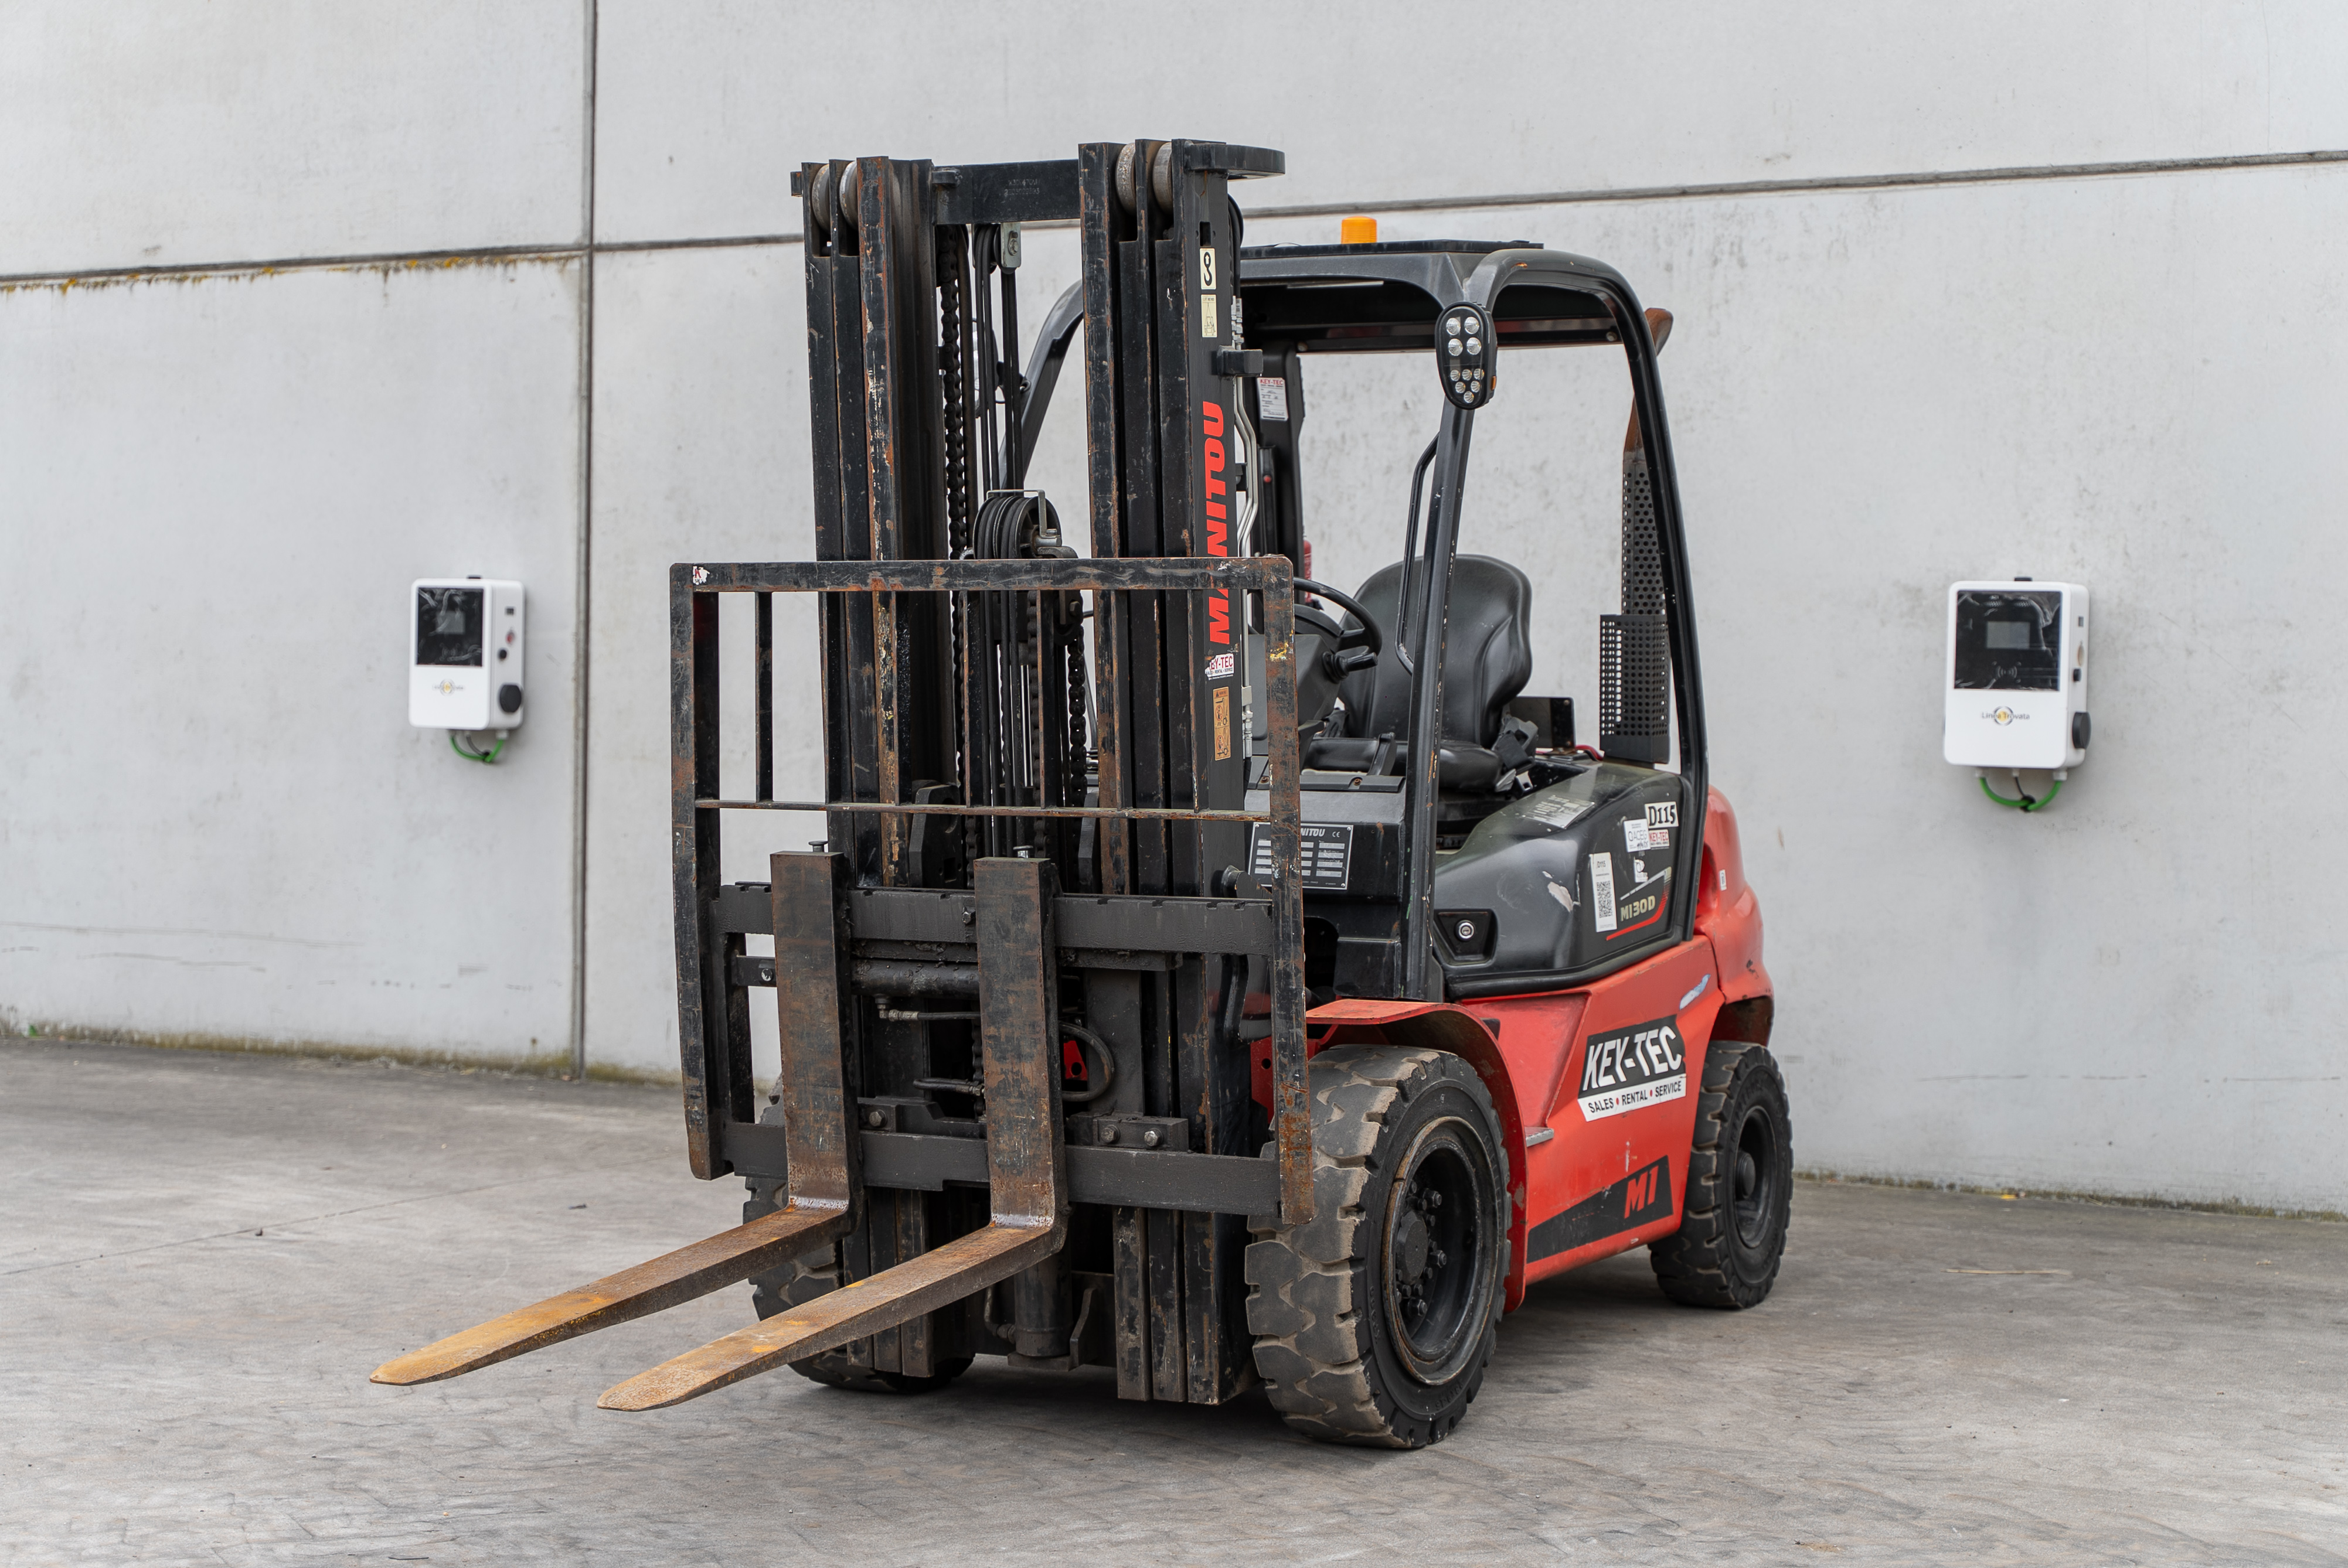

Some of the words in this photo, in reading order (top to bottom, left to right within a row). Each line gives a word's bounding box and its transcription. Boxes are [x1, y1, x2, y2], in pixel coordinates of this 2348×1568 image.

[1203, 401, 1230, 645] MNITOU
[1210, 656, 1233, 669] EY-TEC
[2003, 711, 2030, 720] Trovata
[1648, 805, 1676, 826] D115
[1301, 827, 1326, 837] NITOU
[1583, 1026, 1682, 1091] KEY-TEC
[1588, 1097, 1614, 1113] SALES
[1622, 1090, 1648, 1106] RENTAL
[1655, 1081, 1682, 1097] SERVICE
